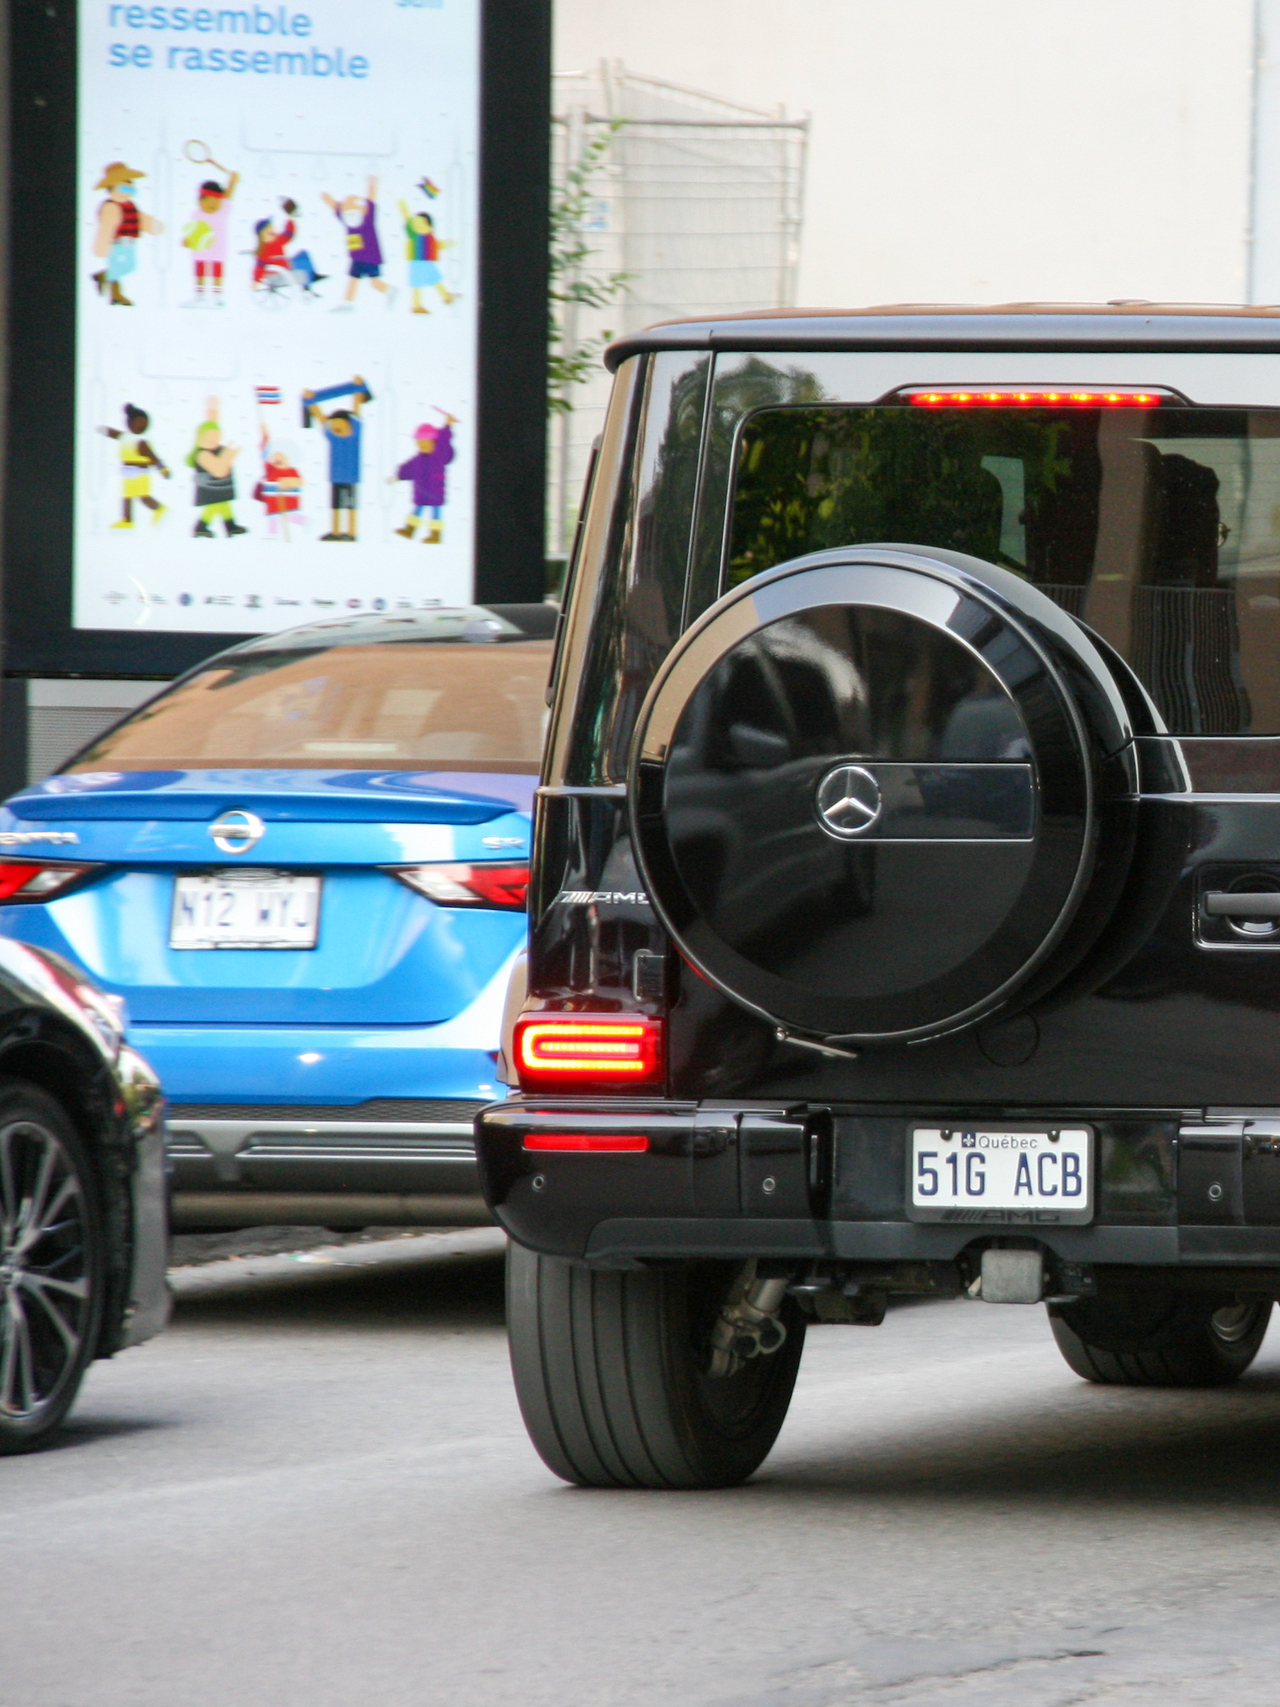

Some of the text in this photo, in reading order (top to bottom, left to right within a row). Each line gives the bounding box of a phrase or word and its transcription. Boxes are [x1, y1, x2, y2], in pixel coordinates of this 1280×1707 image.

[109, 2, 313, 37] ressemble
[109, 42, 370, 79] se rassemble
[978, 1134, 1038, 1149] Québec
[917, 1151, 1082, 1197] 51G ACB
